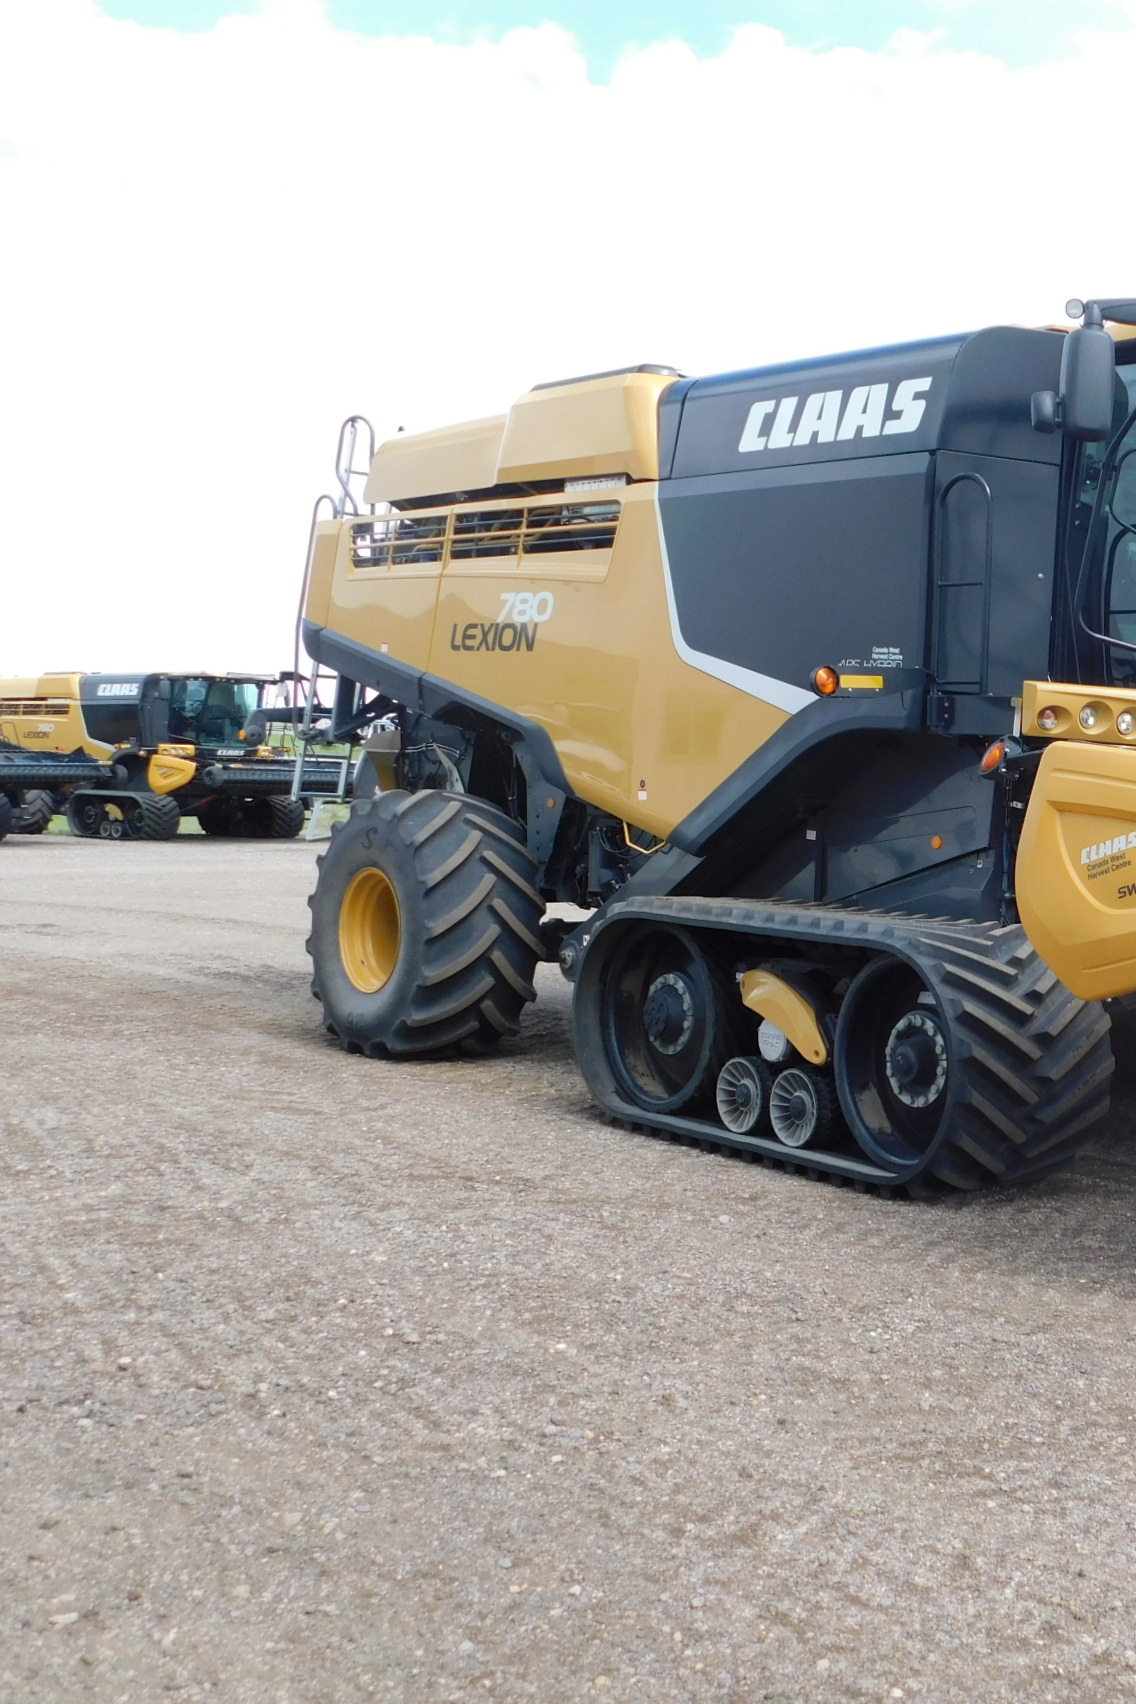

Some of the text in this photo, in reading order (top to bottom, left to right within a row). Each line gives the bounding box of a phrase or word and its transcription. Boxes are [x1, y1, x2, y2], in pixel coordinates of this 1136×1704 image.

[738, 376, 933, 453] CLAAS
[496, 591, 554, 623] 780
[450, 622, 539, 652] LEXION
[872, 646, 888, 654] Canada
[97, 683, 140, 696] CLAAS
[1087, 852, 1126, 872] Canada West
[1087, 859, 1132, 880] Harvest Centre
